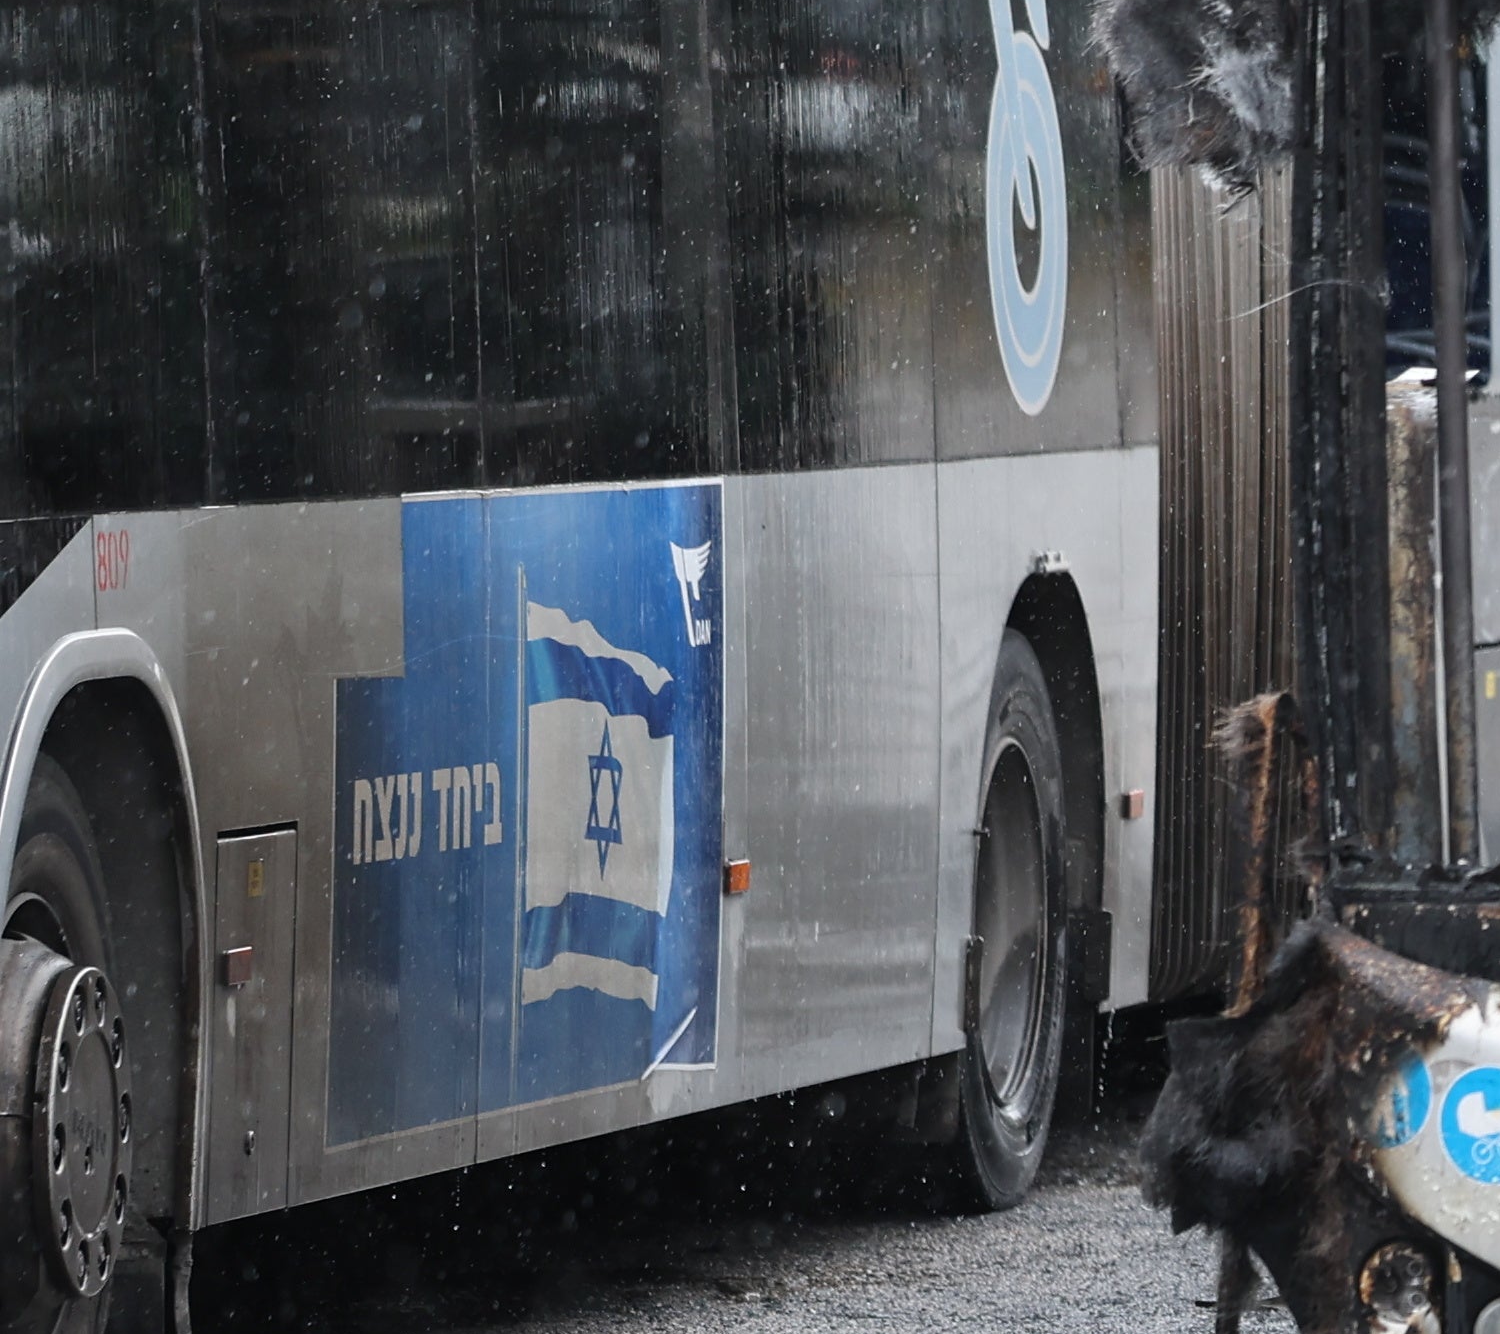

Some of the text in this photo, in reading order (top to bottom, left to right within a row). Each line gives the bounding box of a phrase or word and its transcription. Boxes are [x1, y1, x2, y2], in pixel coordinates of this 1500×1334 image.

[97, 529, 129, 592] 809
[695, 618, 712, 646] DAN
[353, 762, 502, 865] ביחד ננצח
